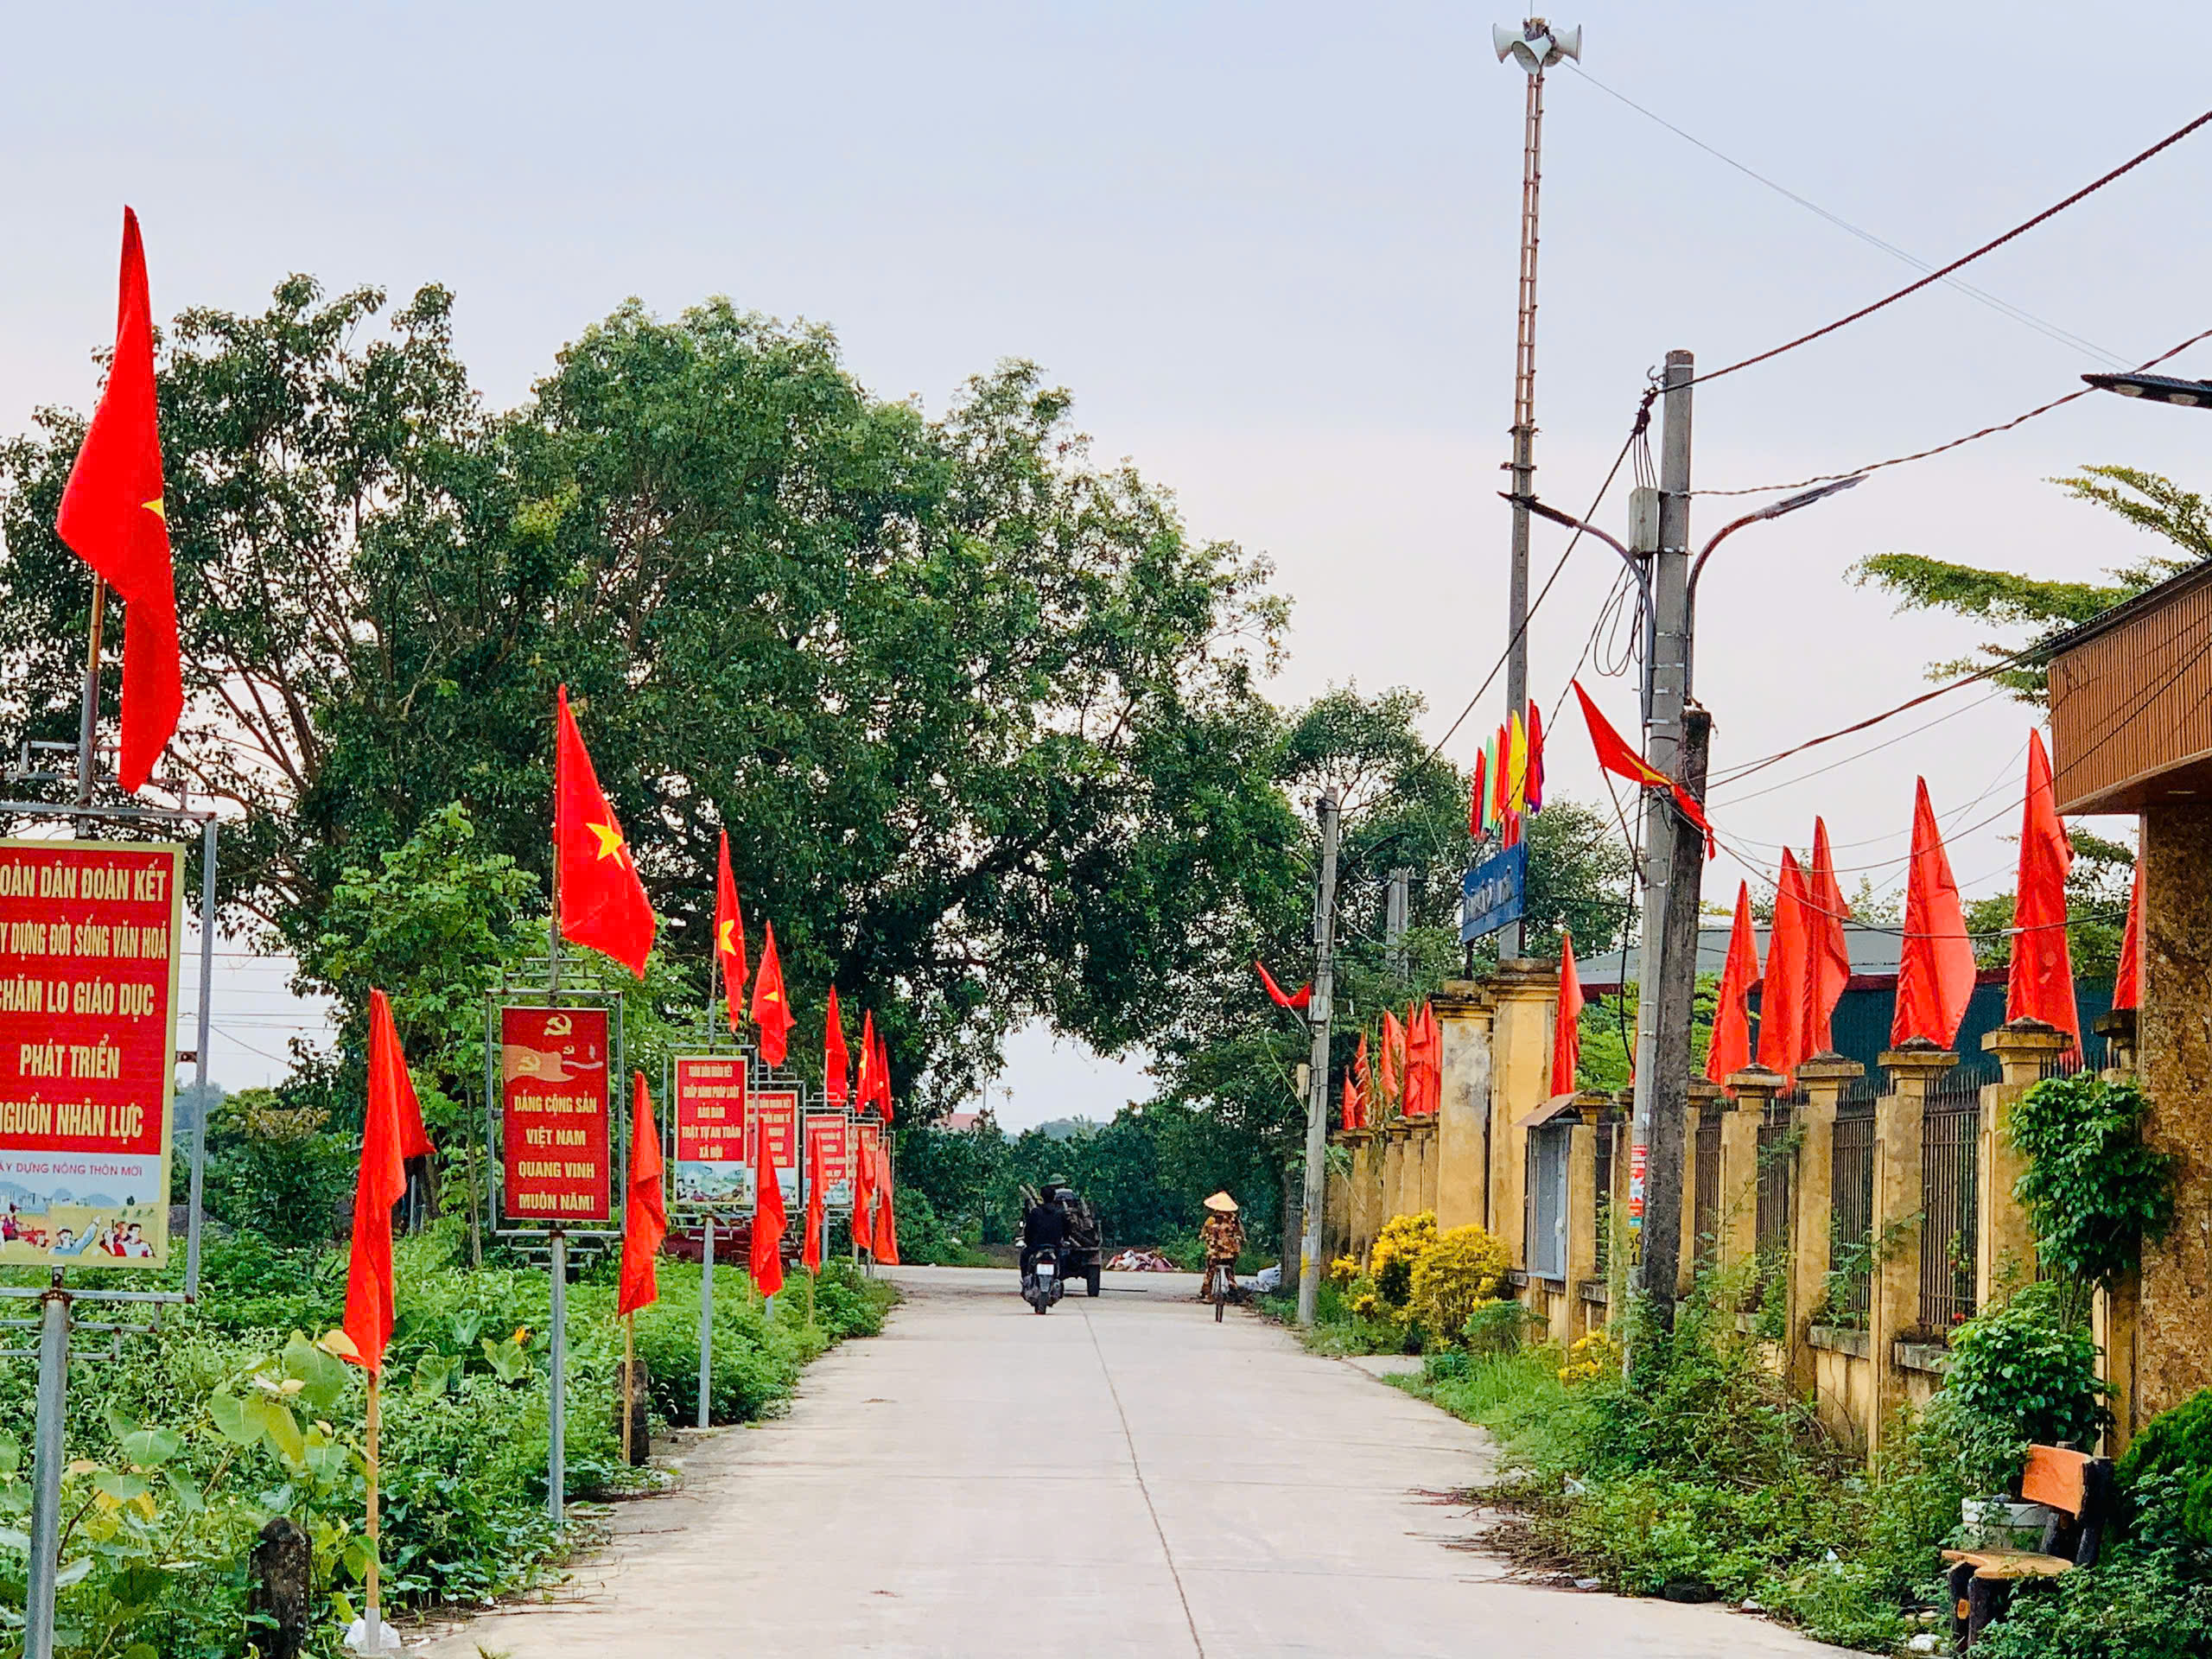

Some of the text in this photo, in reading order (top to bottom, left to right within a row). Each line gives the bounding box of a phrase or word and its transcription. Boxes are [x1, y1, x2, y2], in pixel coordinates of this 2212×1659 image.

[40, 860, 77, 899] DÂN
[81, 861, 130, 900] ĐOÀN
[134, 858, 167, 901] KẾT
[11, 919, 47, 961] DỰNG
[49, 915, 71, 957] ĐỜI
[74, 913, 110, 957] SỐNG
[113, 919, 139, 957] VĂN
[142, 920, 168, 959] HOÁ
[0, 973, 155, 1022] HĂM LO GIÁO DỤC
[19, 1033, 120, 1078] PHÁT TRIỂN
[56, 1097, 106, 1136] NHÂN
[110, 1103, 143, 1144] LỰC
[544, 1093, 573, 1116] CỘNG
[575, 1090, 597, 1113] SẢN
[525, 1125, 586, 1148] VIỆT NAM
[518, 1160, 594, 1179] QUANG VINH
[518, 1191, 556, 1211] MUÔN
